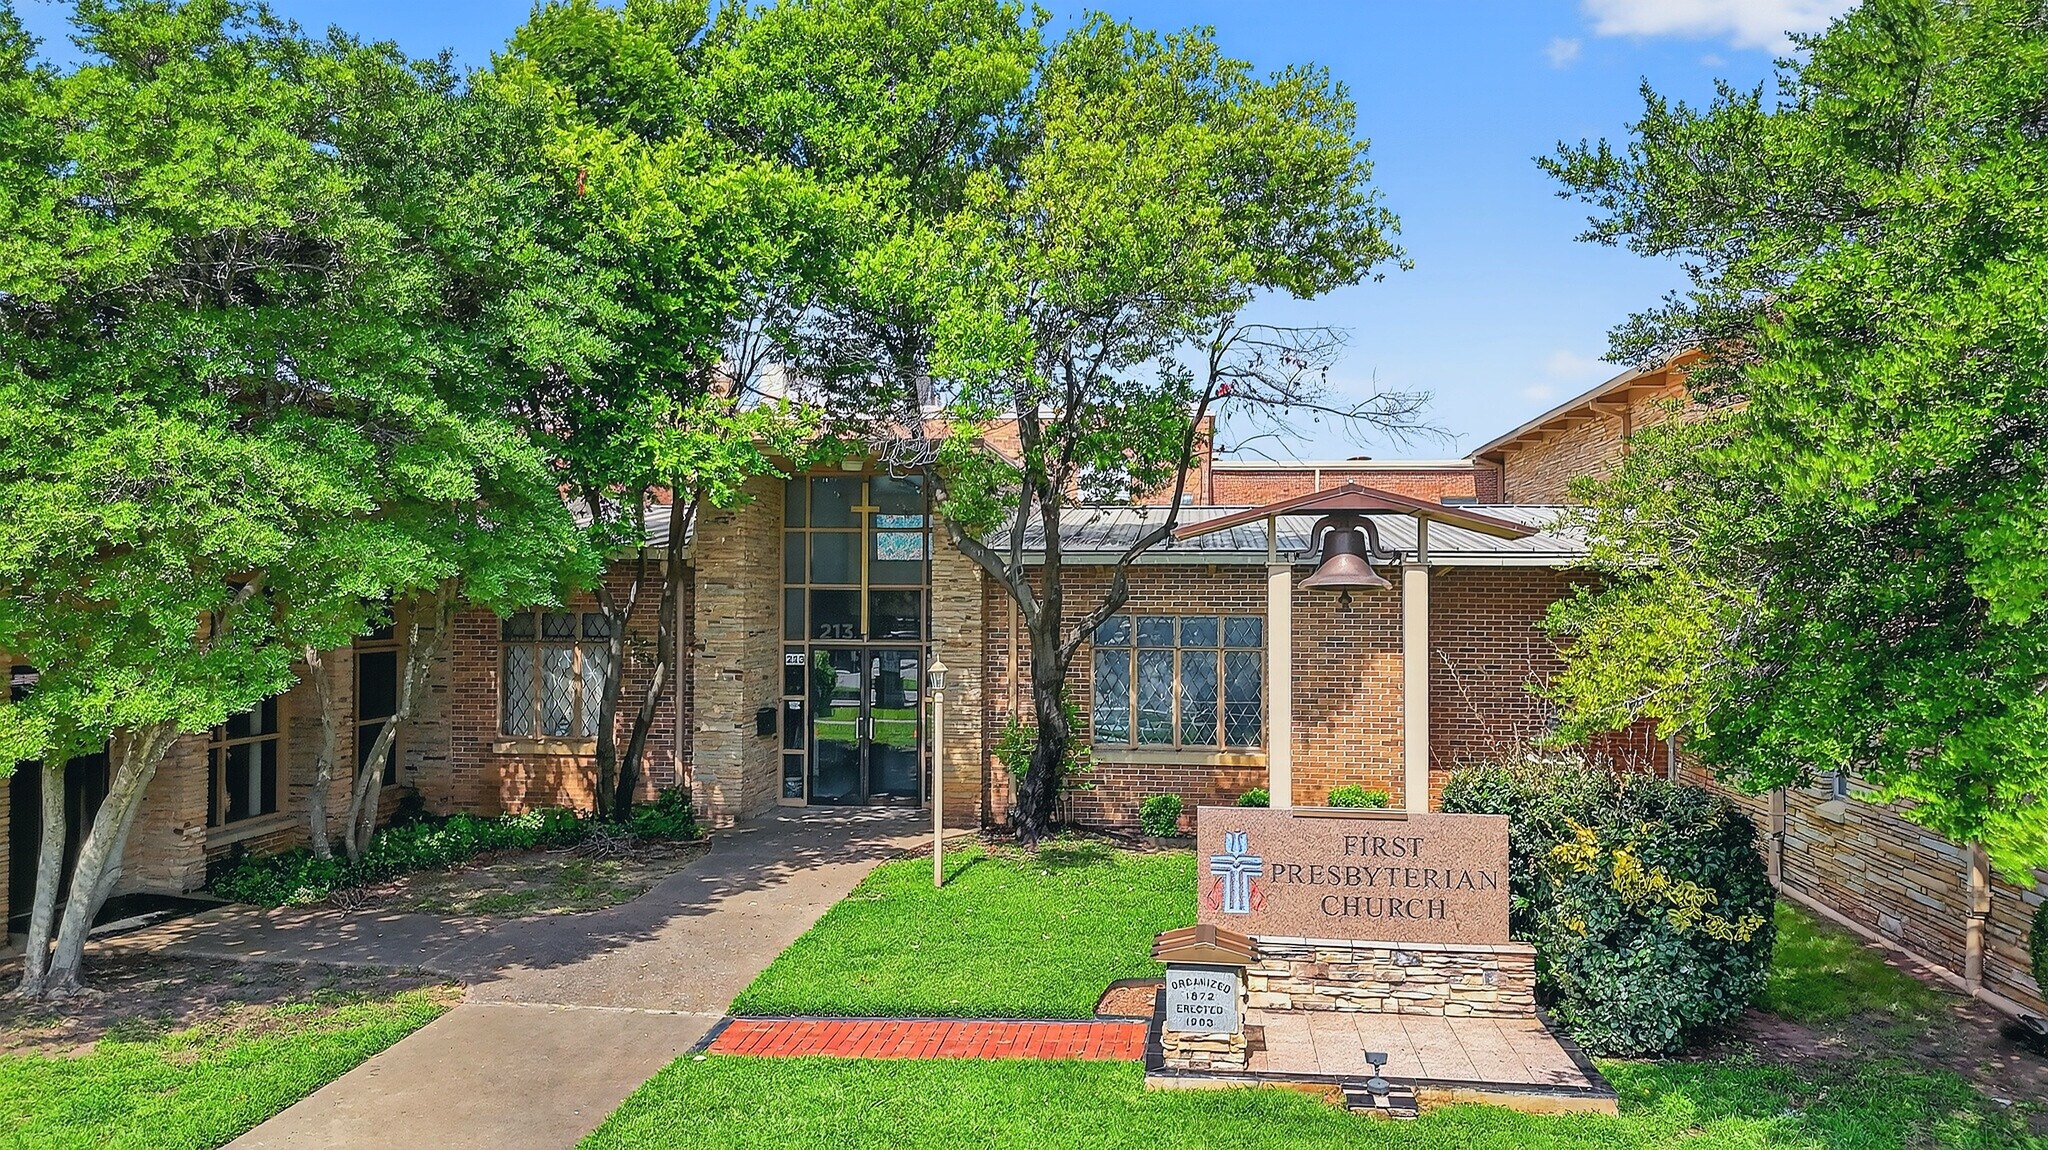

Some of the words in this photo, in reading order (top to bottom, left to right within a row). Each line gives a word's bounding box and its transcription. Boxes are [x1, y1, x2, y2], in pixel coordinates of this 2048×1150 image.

[820, 623, 854, 639] 213
[1343, 835, 1424, 859] FIRST
[1270, 863, 1499, 891] PRESBYTERIAN
[1321, 895, 1447, 920] CHURCH
[1171, 977, 1231, 994] ORGANIZED
[1186, 992, 1215, 1001] 1872
[1176, 1004, 1223, 1015] ERECTED
[1186, 1018, 1214, 1028] 1903
